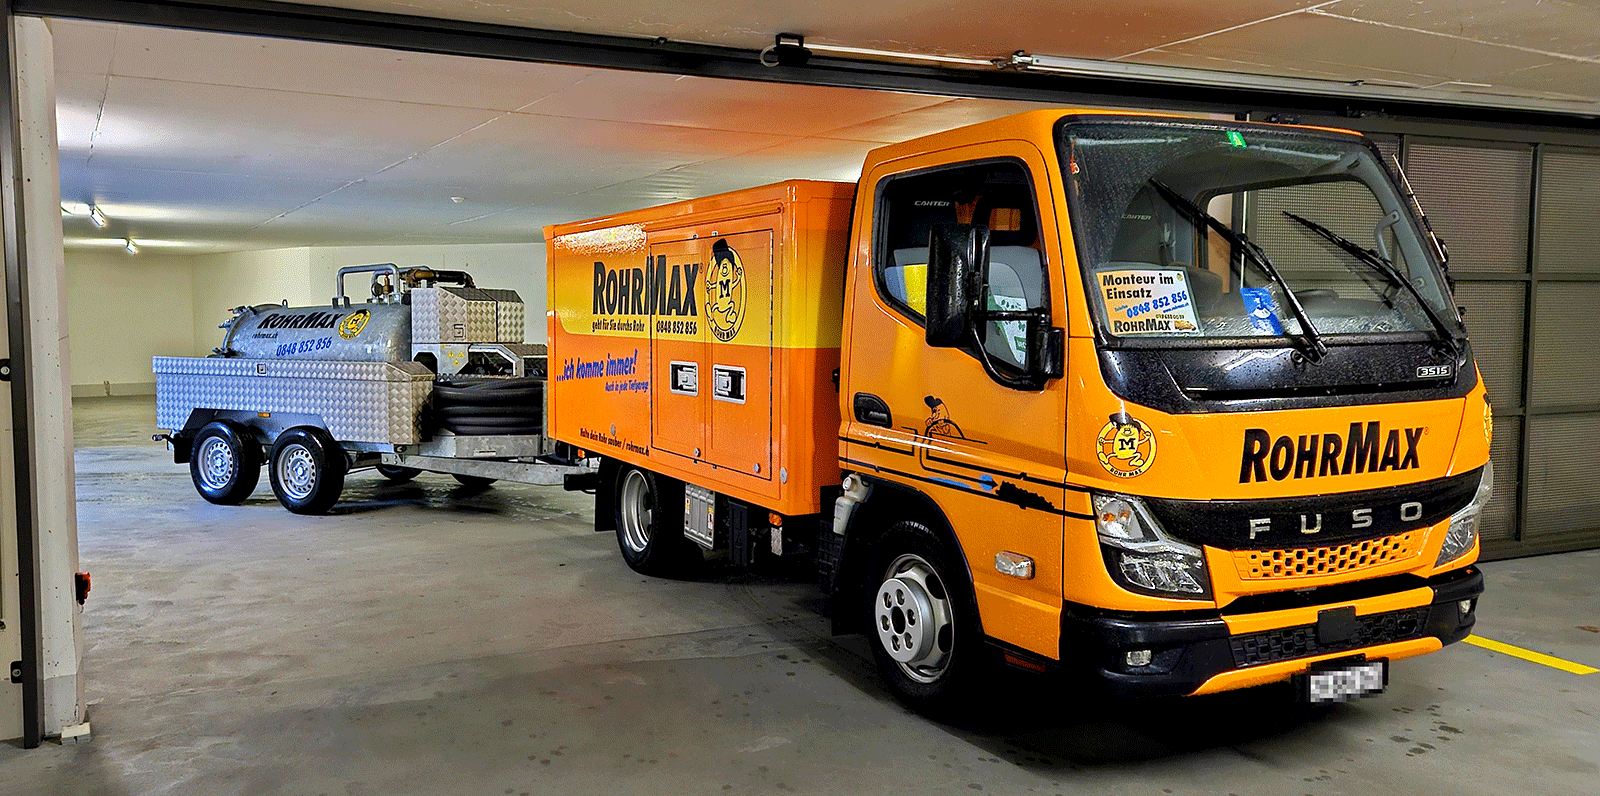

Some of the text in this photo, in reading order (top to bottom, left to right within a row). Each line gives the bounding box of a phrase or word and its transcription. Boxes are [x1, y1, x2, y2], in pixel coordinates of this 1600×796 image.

[1103, 273, 1174, 286] Monteur im
[719, 279, 730, 299] M
[1106, 287, 1152, 300] Einsatz
[1126, 302, 1150, 318] 0848
[1152, 296, 1170, 310] 852
[1171, 290, 1188, 304] 856
[592, 318, 602, 333] geht
[617, 319, 632, 332] durchs
[633, 319, 645, 332] Rohr
[656, 320, 697, 335] 0848 852 856
[276, 343, 297, 357] 0848
[299, 339, 315, 354] 852
[315, 336, 332, 351] 856
[576, 357, 604, 379] komme
[606, 348, 638, 377] immer!
[598, 433, 608, 444] Rohr
[608, 436, 622, 448] sauber
[1119, 438, 1135, 451] M
[1110, 467, 1127, 477] ROHR
[1249, 501, 1422, 540] FUSO
